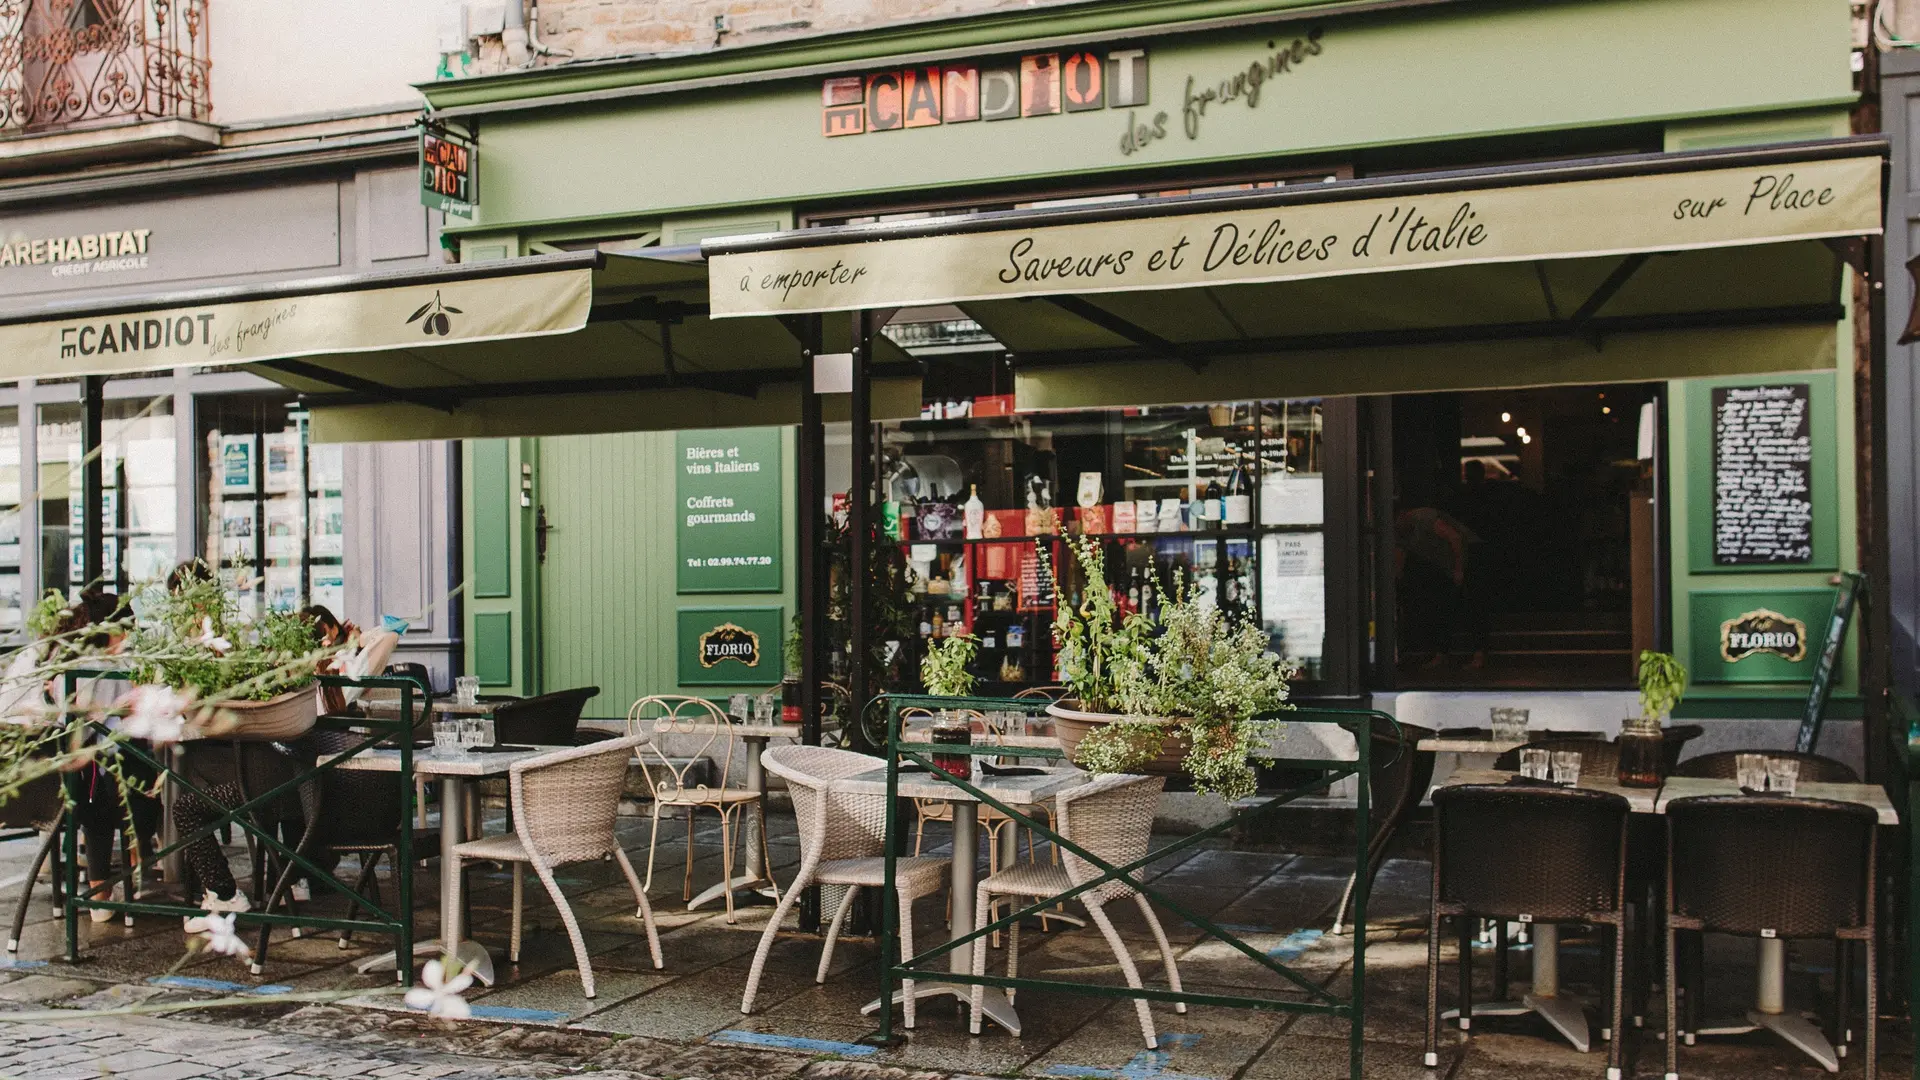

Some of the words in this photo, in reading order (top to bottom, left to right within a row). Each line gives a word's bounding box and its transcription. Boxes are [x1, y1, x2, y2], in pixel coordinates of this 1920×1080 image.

[867, 49, 1148, 132] CANDIOT
[1120, 107, 1167, 156] des
[1182, 33, 1324, 139] frangines
[1673, 197, 1728, 220] sur
[1743, 173, 1836, 216] Place
[999, 237, 1134, 285] Saveurs
[1147, 237, 1190, 273] et
[1202, 218, 1338, 273] Délices
[1353, 202, 1488, 258] d'Italie
[93, 257, 148, 273] AGRICOLE
[739, 265, 754, 292] à
[760, 259, 868, 302] emporter
[78, 313, 215, 356] CANDIOT
[209, 334, 231, 358] des
[236, 303, 298, 353] frangines
[686, 447, 724, 459] Bières
[727, 446, 739, 458] et
[686, 463, 712, 475] vins
[715, 460, 760, 474] Italiens
[686, 495, 734, 509] Coffrets
[686, 509, 756, 527] gourmands
[1729, 632, 1797, 649] FLORIO
[706, 643, 753, 656] FLORIO
